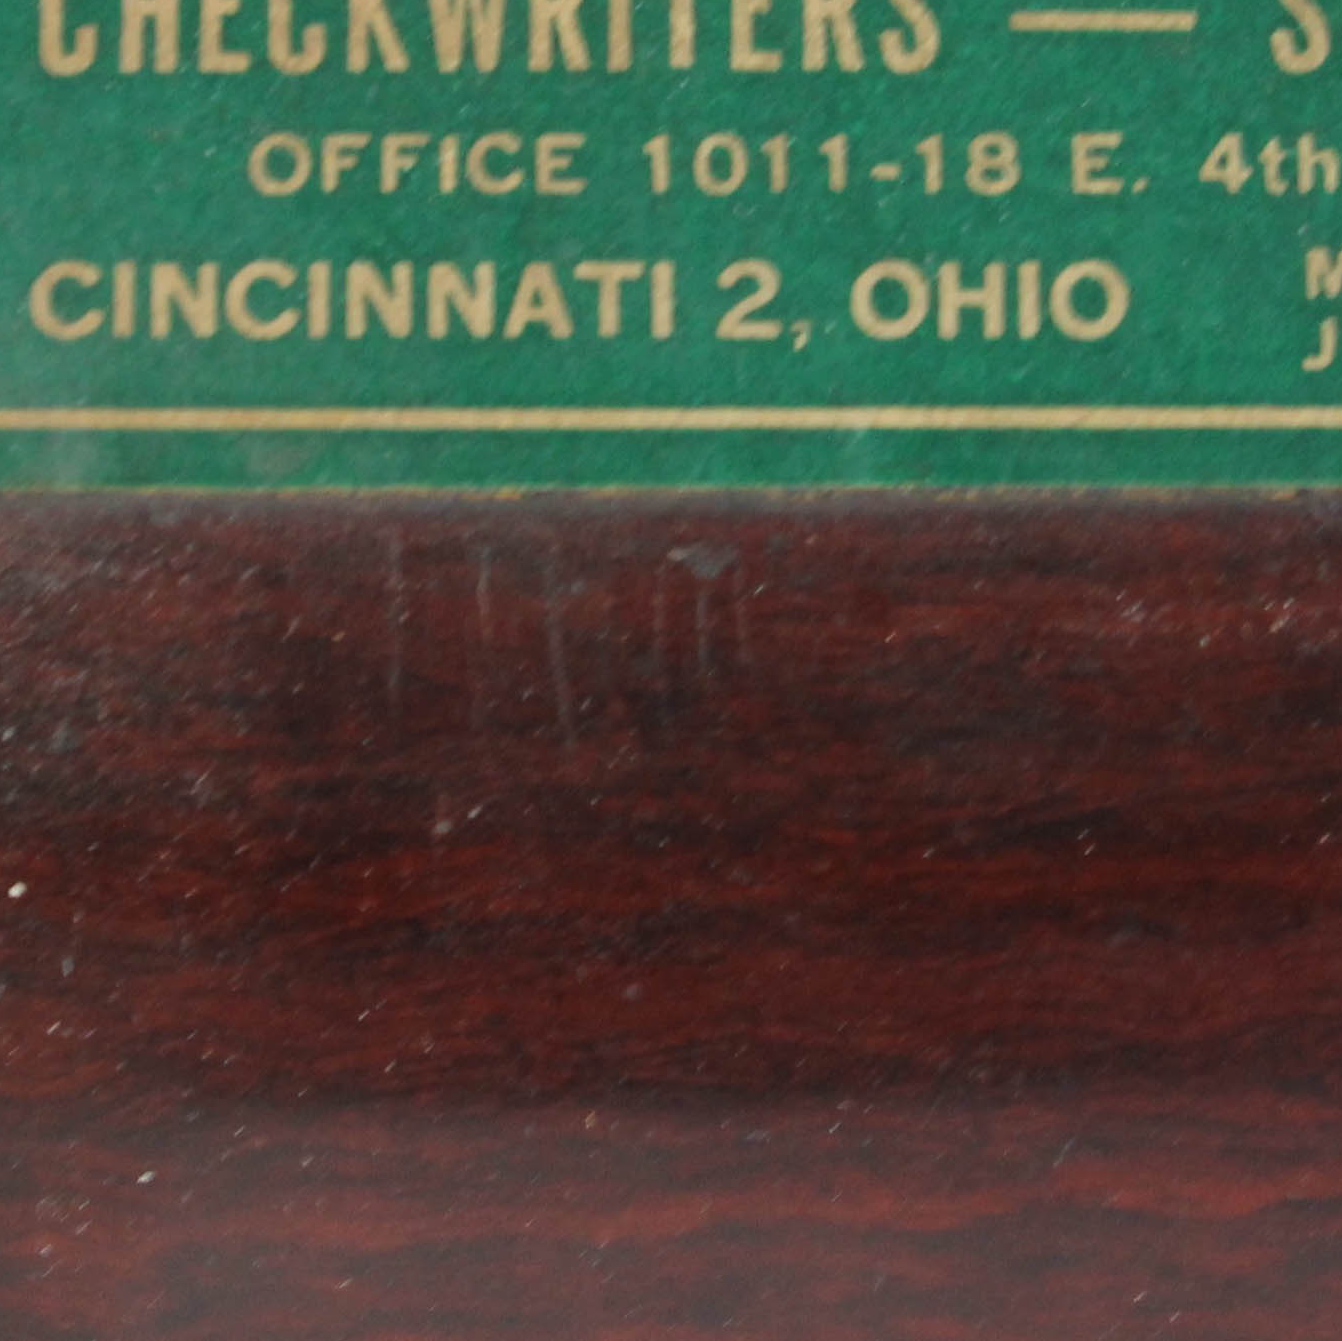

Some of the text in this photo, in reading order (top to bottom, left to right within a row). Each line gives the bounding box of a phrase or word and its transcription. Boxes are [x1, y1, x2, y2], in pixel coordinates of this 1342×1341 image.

[247, 131, 587, 197] OFFICE
[642, 132, 1022, 197] 1011-18
[1070, 131, 1149, 195] E.
[1199, 131, 1341, 196] 4th
[28, 258, 1131, 351] CINCINNATI 2, OHIO
